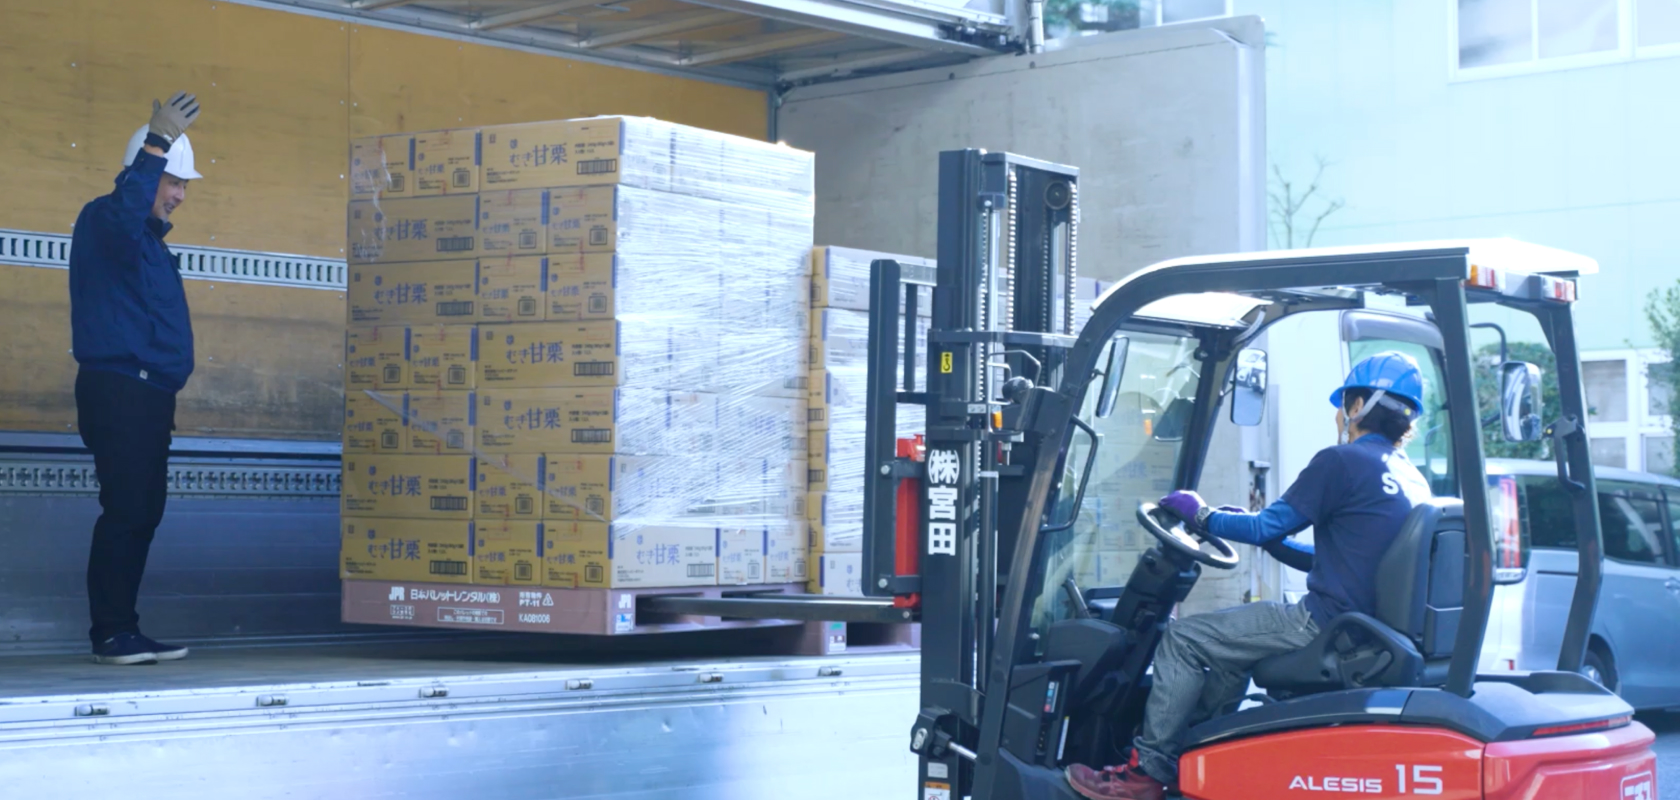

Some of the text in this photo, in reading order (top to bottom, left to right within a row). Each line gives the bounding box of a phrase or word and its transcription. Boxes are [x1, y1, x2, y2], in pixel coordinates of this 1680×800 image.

[509, 143, 568, 168] むき甘栗
[374, 219, 428, 242] むき甘栗
[374, 282, 428, 305] むき甘栗
[506, 341, 564, 364] むき甘栗
[504, 407, 562, 431] むき甘栗
[368, 475, 422, 496] むき甘栗
[367, 538, 421, 561] むき甘栗
[636, 543, 680, 566] むき甘栗
[389, 586, 405, 601] JPR
[1289, 763, 1444, 796] ALESIS 15
